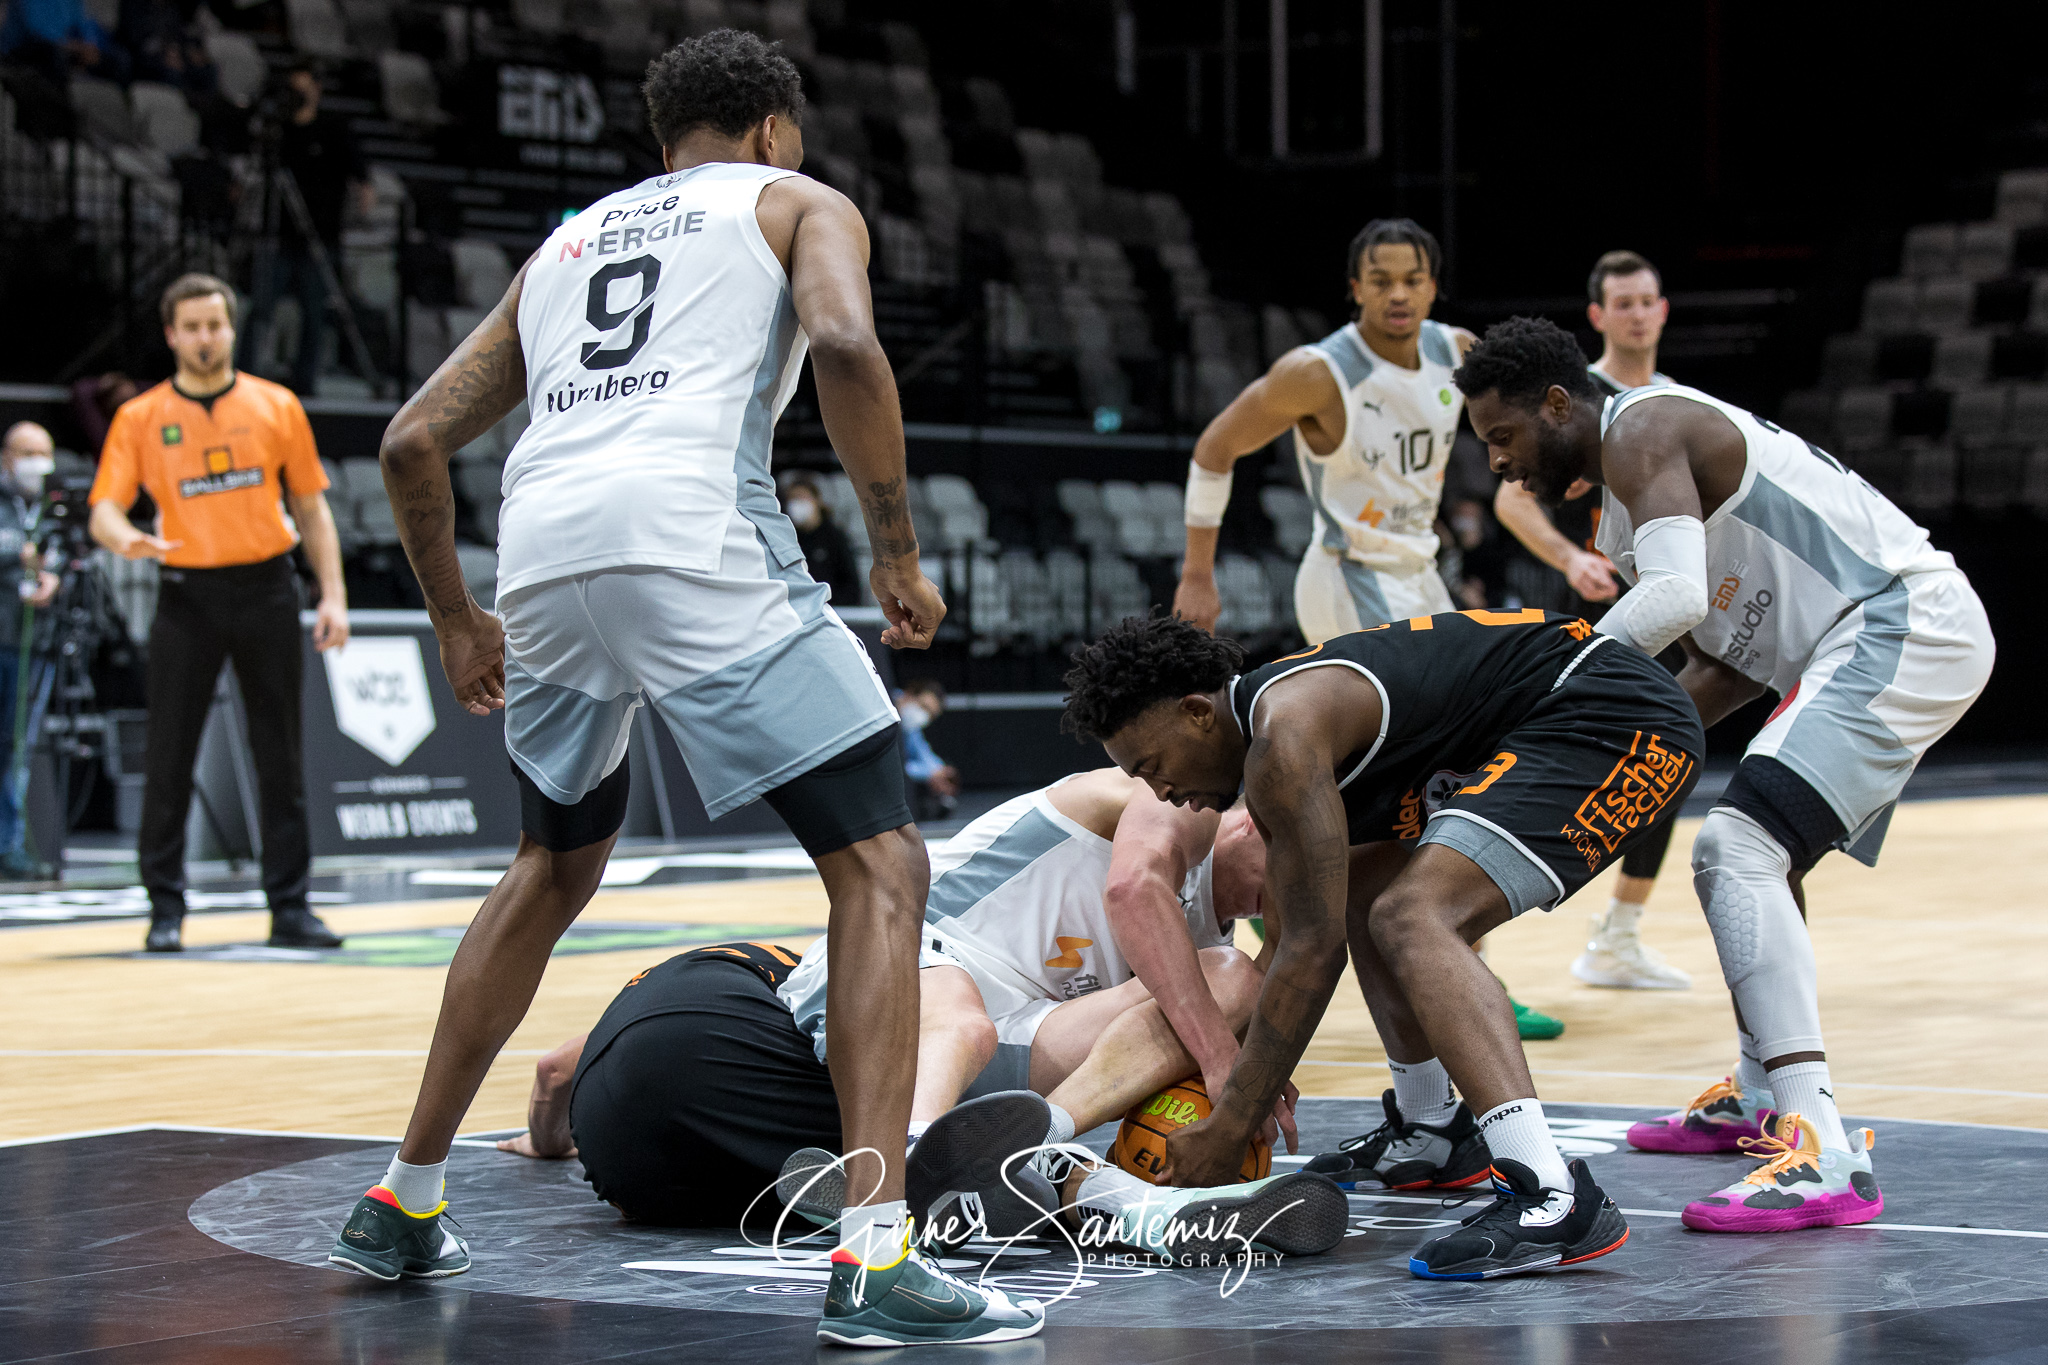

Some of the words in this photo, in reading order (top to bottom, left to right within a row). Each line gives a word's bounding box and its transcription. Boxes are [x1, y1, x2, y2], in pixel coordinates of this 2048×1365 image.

[600, 195, 680, 228] Price
[580, 253, 662, 370] 9
[1393, 428, 1434, 476] 10
[1574, 730, 1668, 836] Fischer
